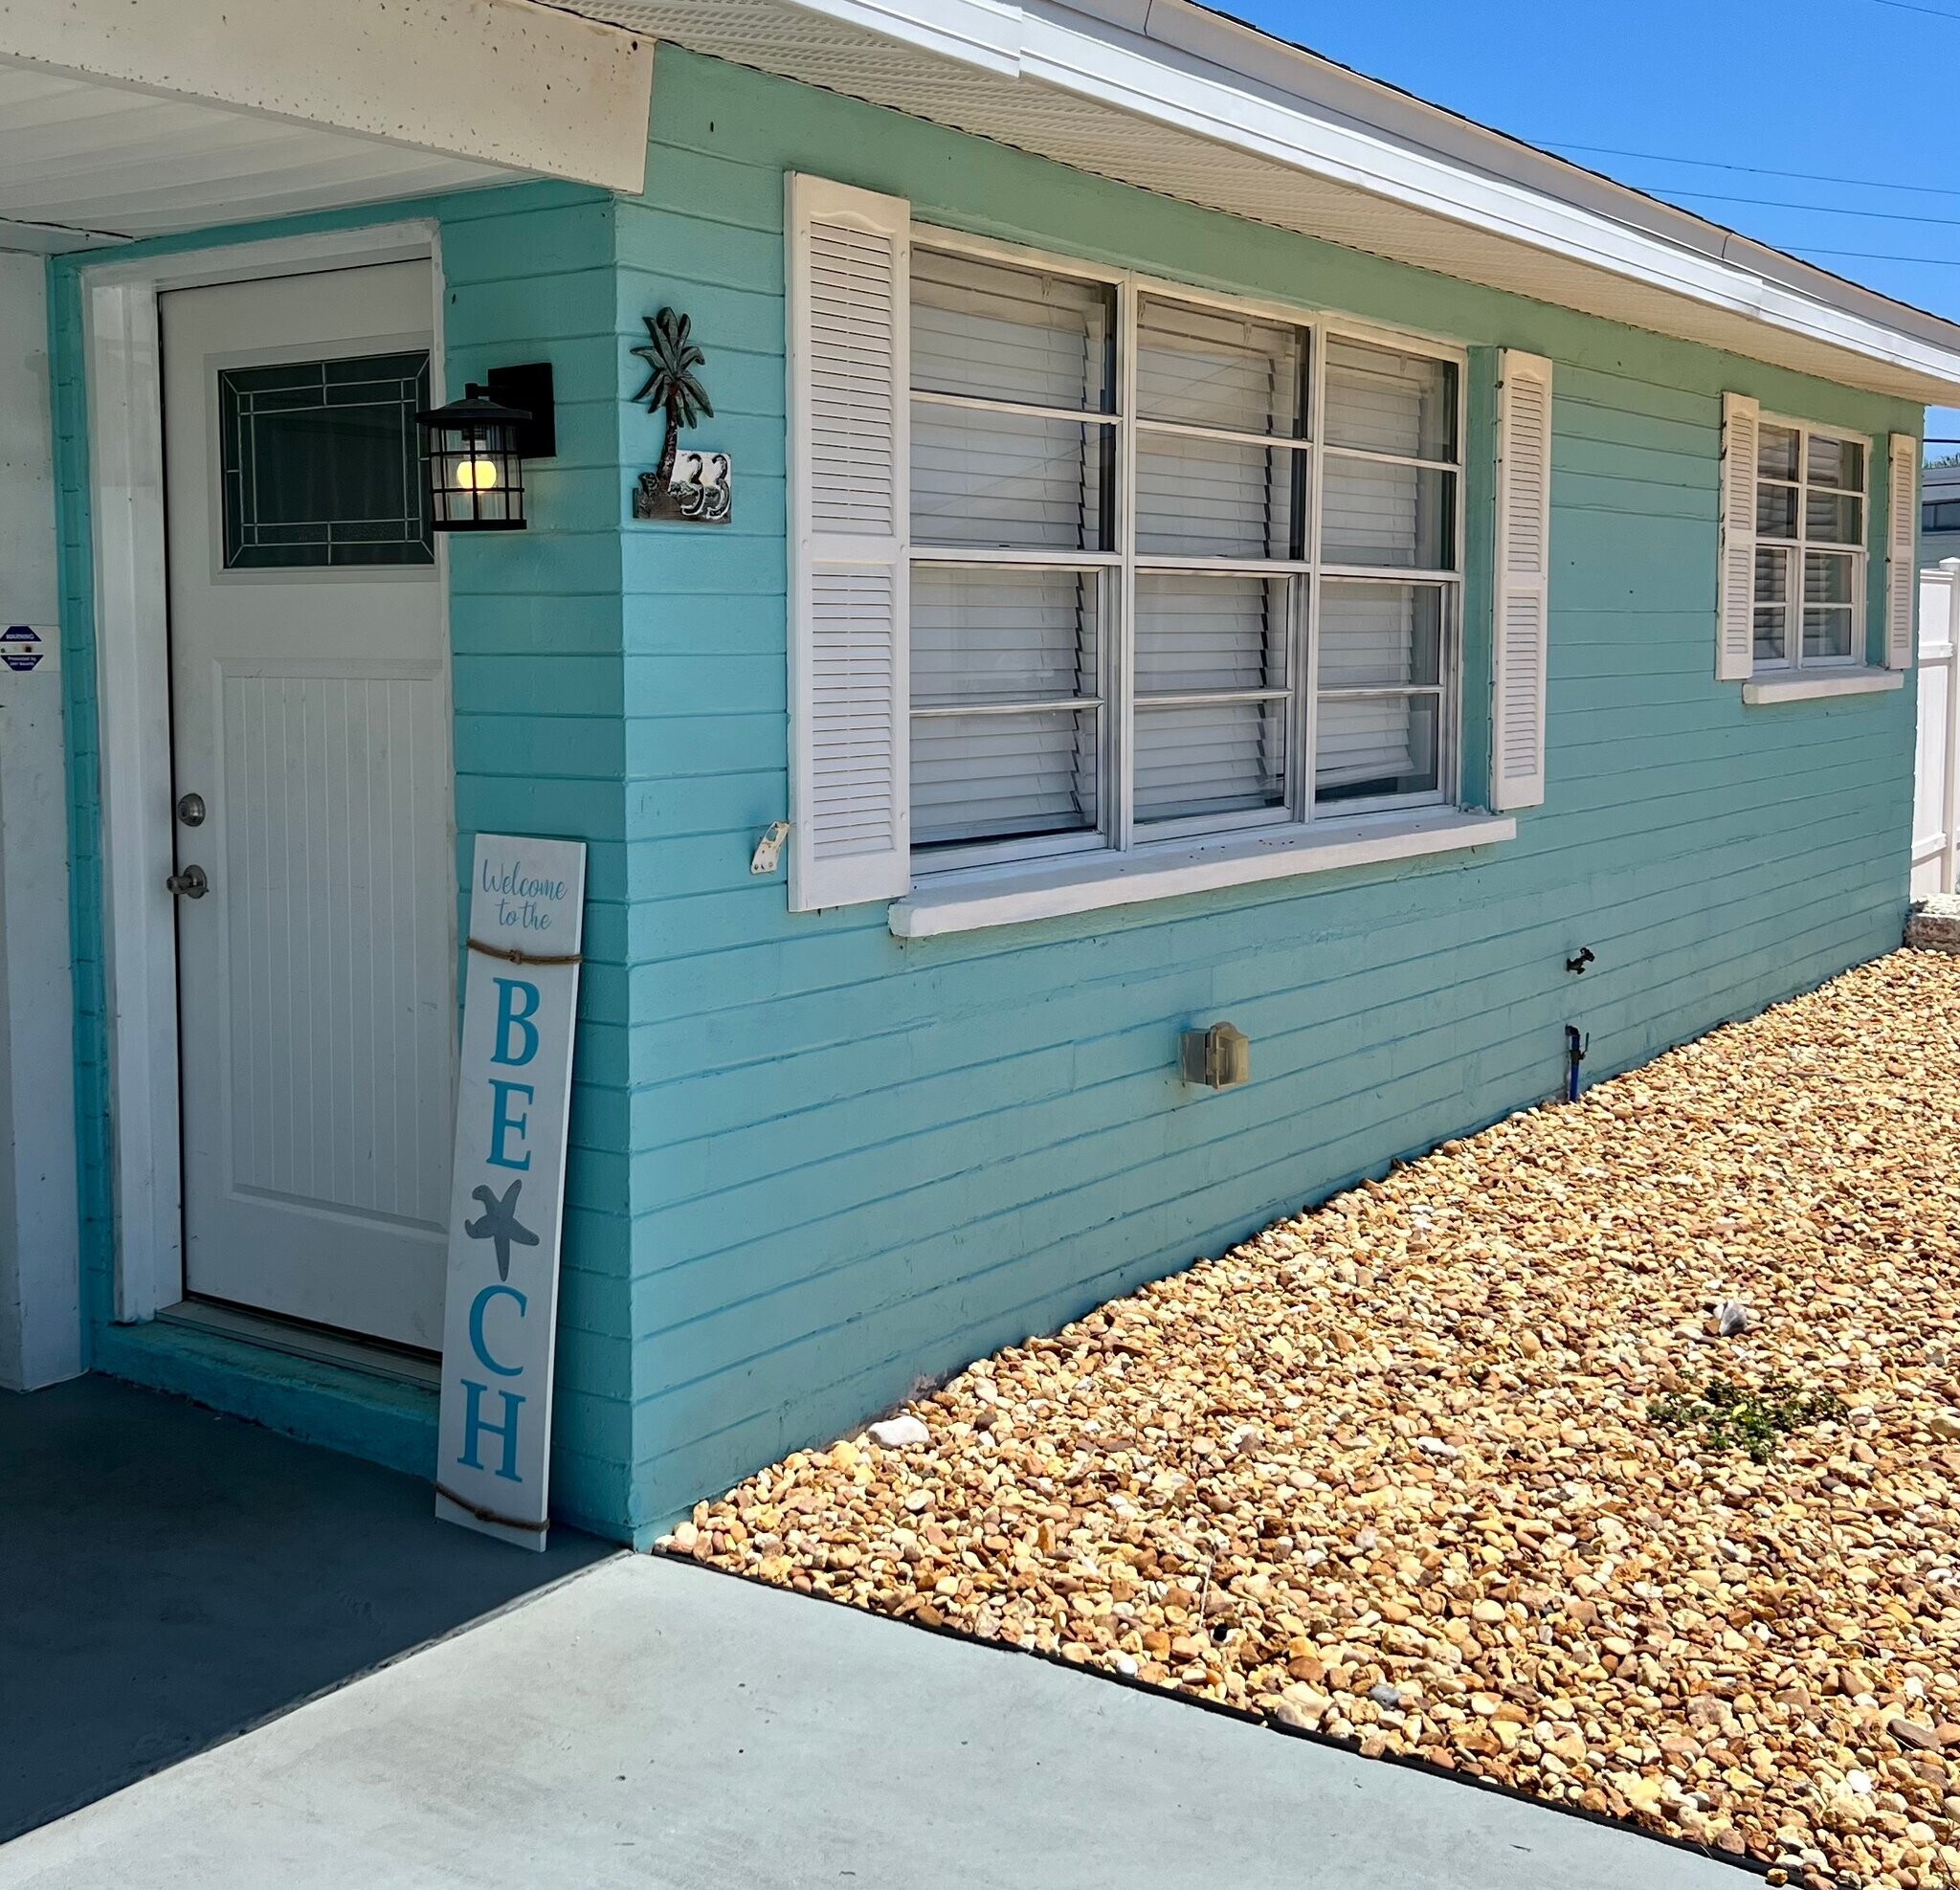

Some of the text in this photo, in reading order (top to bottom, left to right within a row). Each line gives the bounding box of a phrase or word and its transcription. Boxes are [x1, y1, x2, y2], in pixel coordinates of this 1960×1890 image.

[680, 454, 730, 520] 33
[482, 859, 568, 901] Welcome
[495, 899, 551, 930] to the
